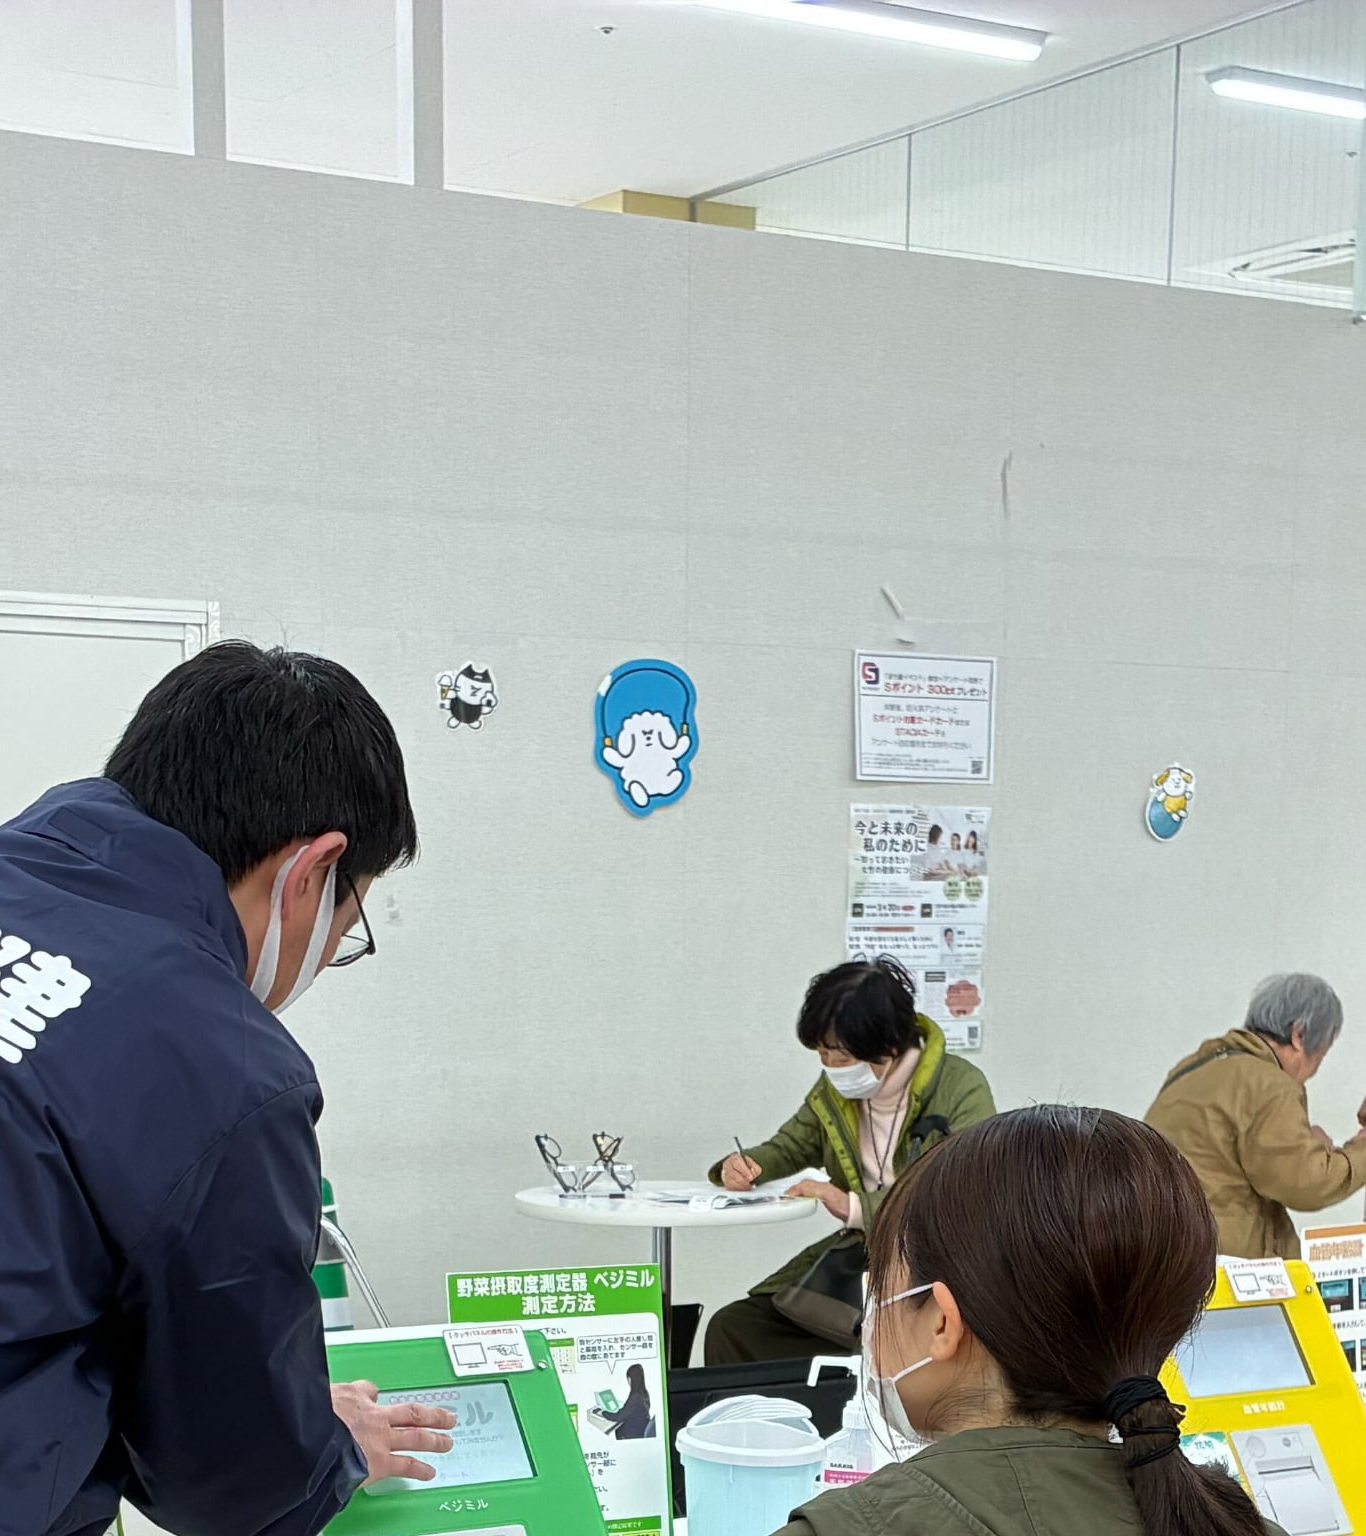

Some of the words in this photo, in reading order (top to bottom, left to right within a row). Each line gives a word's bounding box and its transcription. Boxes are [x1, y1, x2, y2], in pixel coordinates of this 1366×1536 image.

[855, 820, 918, 836] 今と未来の
[863, 837, 926, 852] 私のために
[456, 1273, 587, 1298] 野菜摂取度測定器
[593, 1269, 654, 1289] ベジミル
[522, 1294, 596, 1315] 測定方法
[439, 1499, 488, 1512] ベジミル
